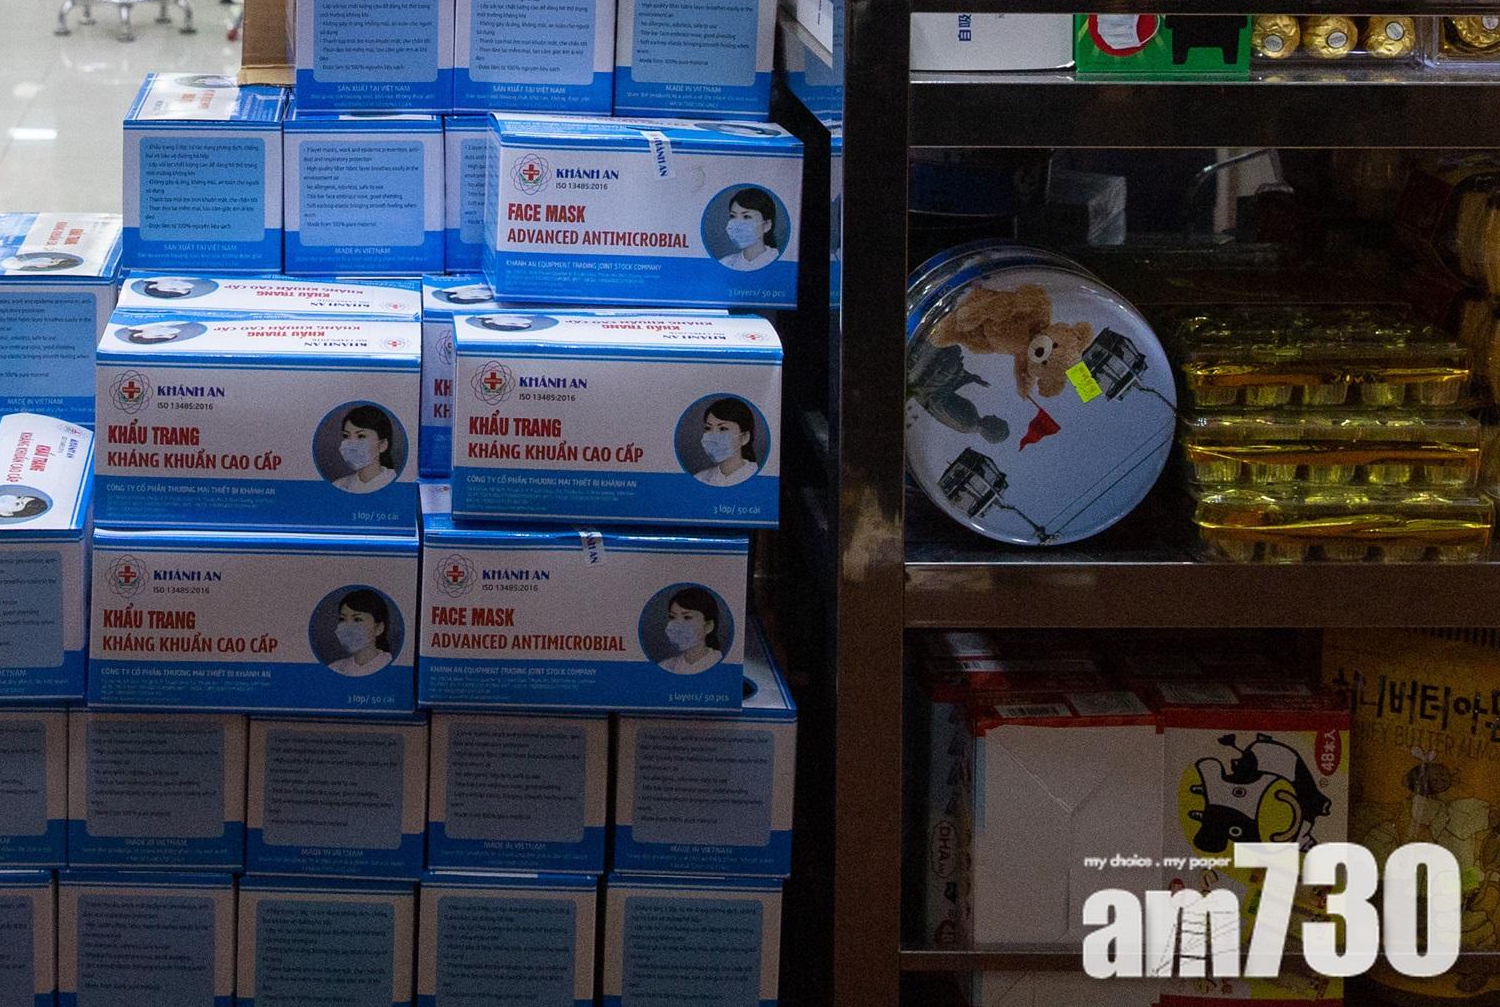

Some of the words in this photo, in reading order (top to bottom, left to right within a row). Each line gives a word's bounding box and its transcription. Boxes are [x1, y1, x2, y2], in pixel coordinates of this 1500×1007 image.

[556, 167, 600, 179] KHÁNH
[602, 169, 619, 180] AN
[658, 164, 668, 177] AN
[508, 203, 542, 221] FACE
[546, 204, 586, 223] MASK
[507, 228, 578, 245] ADVANCED
[582, 231, 688, 248] ANTIMICROBIAL
[363, 248, 391, 256] VIETNAM
[157, 383, 204, 397] KHÁNH
[206, 387, 225, 397] AN
[519, 374, 566, 389] KHÁNH
[569, 378, 587, 389] AN
[519, 393, 530, 401] ISO
[108, 419, 147, 444] KHẨU
[152, 426, 200, 445] TRANG
[469, 410, 509, 436] KHẨU
[514, 417, 562, 438] TRANG
[108, 450, 159, 468] KHÁNG
[164, 448, 216, 469] KHUẨN
[221, 455, 249, 469] CAO
[254, 450, 282, 470] CẤP
[468, 441, 520, 458] KHÁNG
[525, 440, 577, 461] KHUẨN
[582, 446, 612, 463] CAO
[616, 443, 643, 463] CẤP
[203, 571, 222, 581] AN
[532, 570, 550, 581] AN
[104, 604, 143, 628] KHẨU
[148, 610, 196, 630] TRANG
[432, 606, 466, 625] FACE
[472, 608, 515, 626] MASK
[103, 634, 155, 651] KHÁNG
[159, 633, 212, 652] KHUẨN
[217, 638, 245, 653] CAO
[250, 634, 278, 654] CẤP
[431, 633, 506, 650] ADVANCED
[512, 635, 626, 652] ANTIMICROBIAL
[1319, 729, 1337, 771] 48本入
